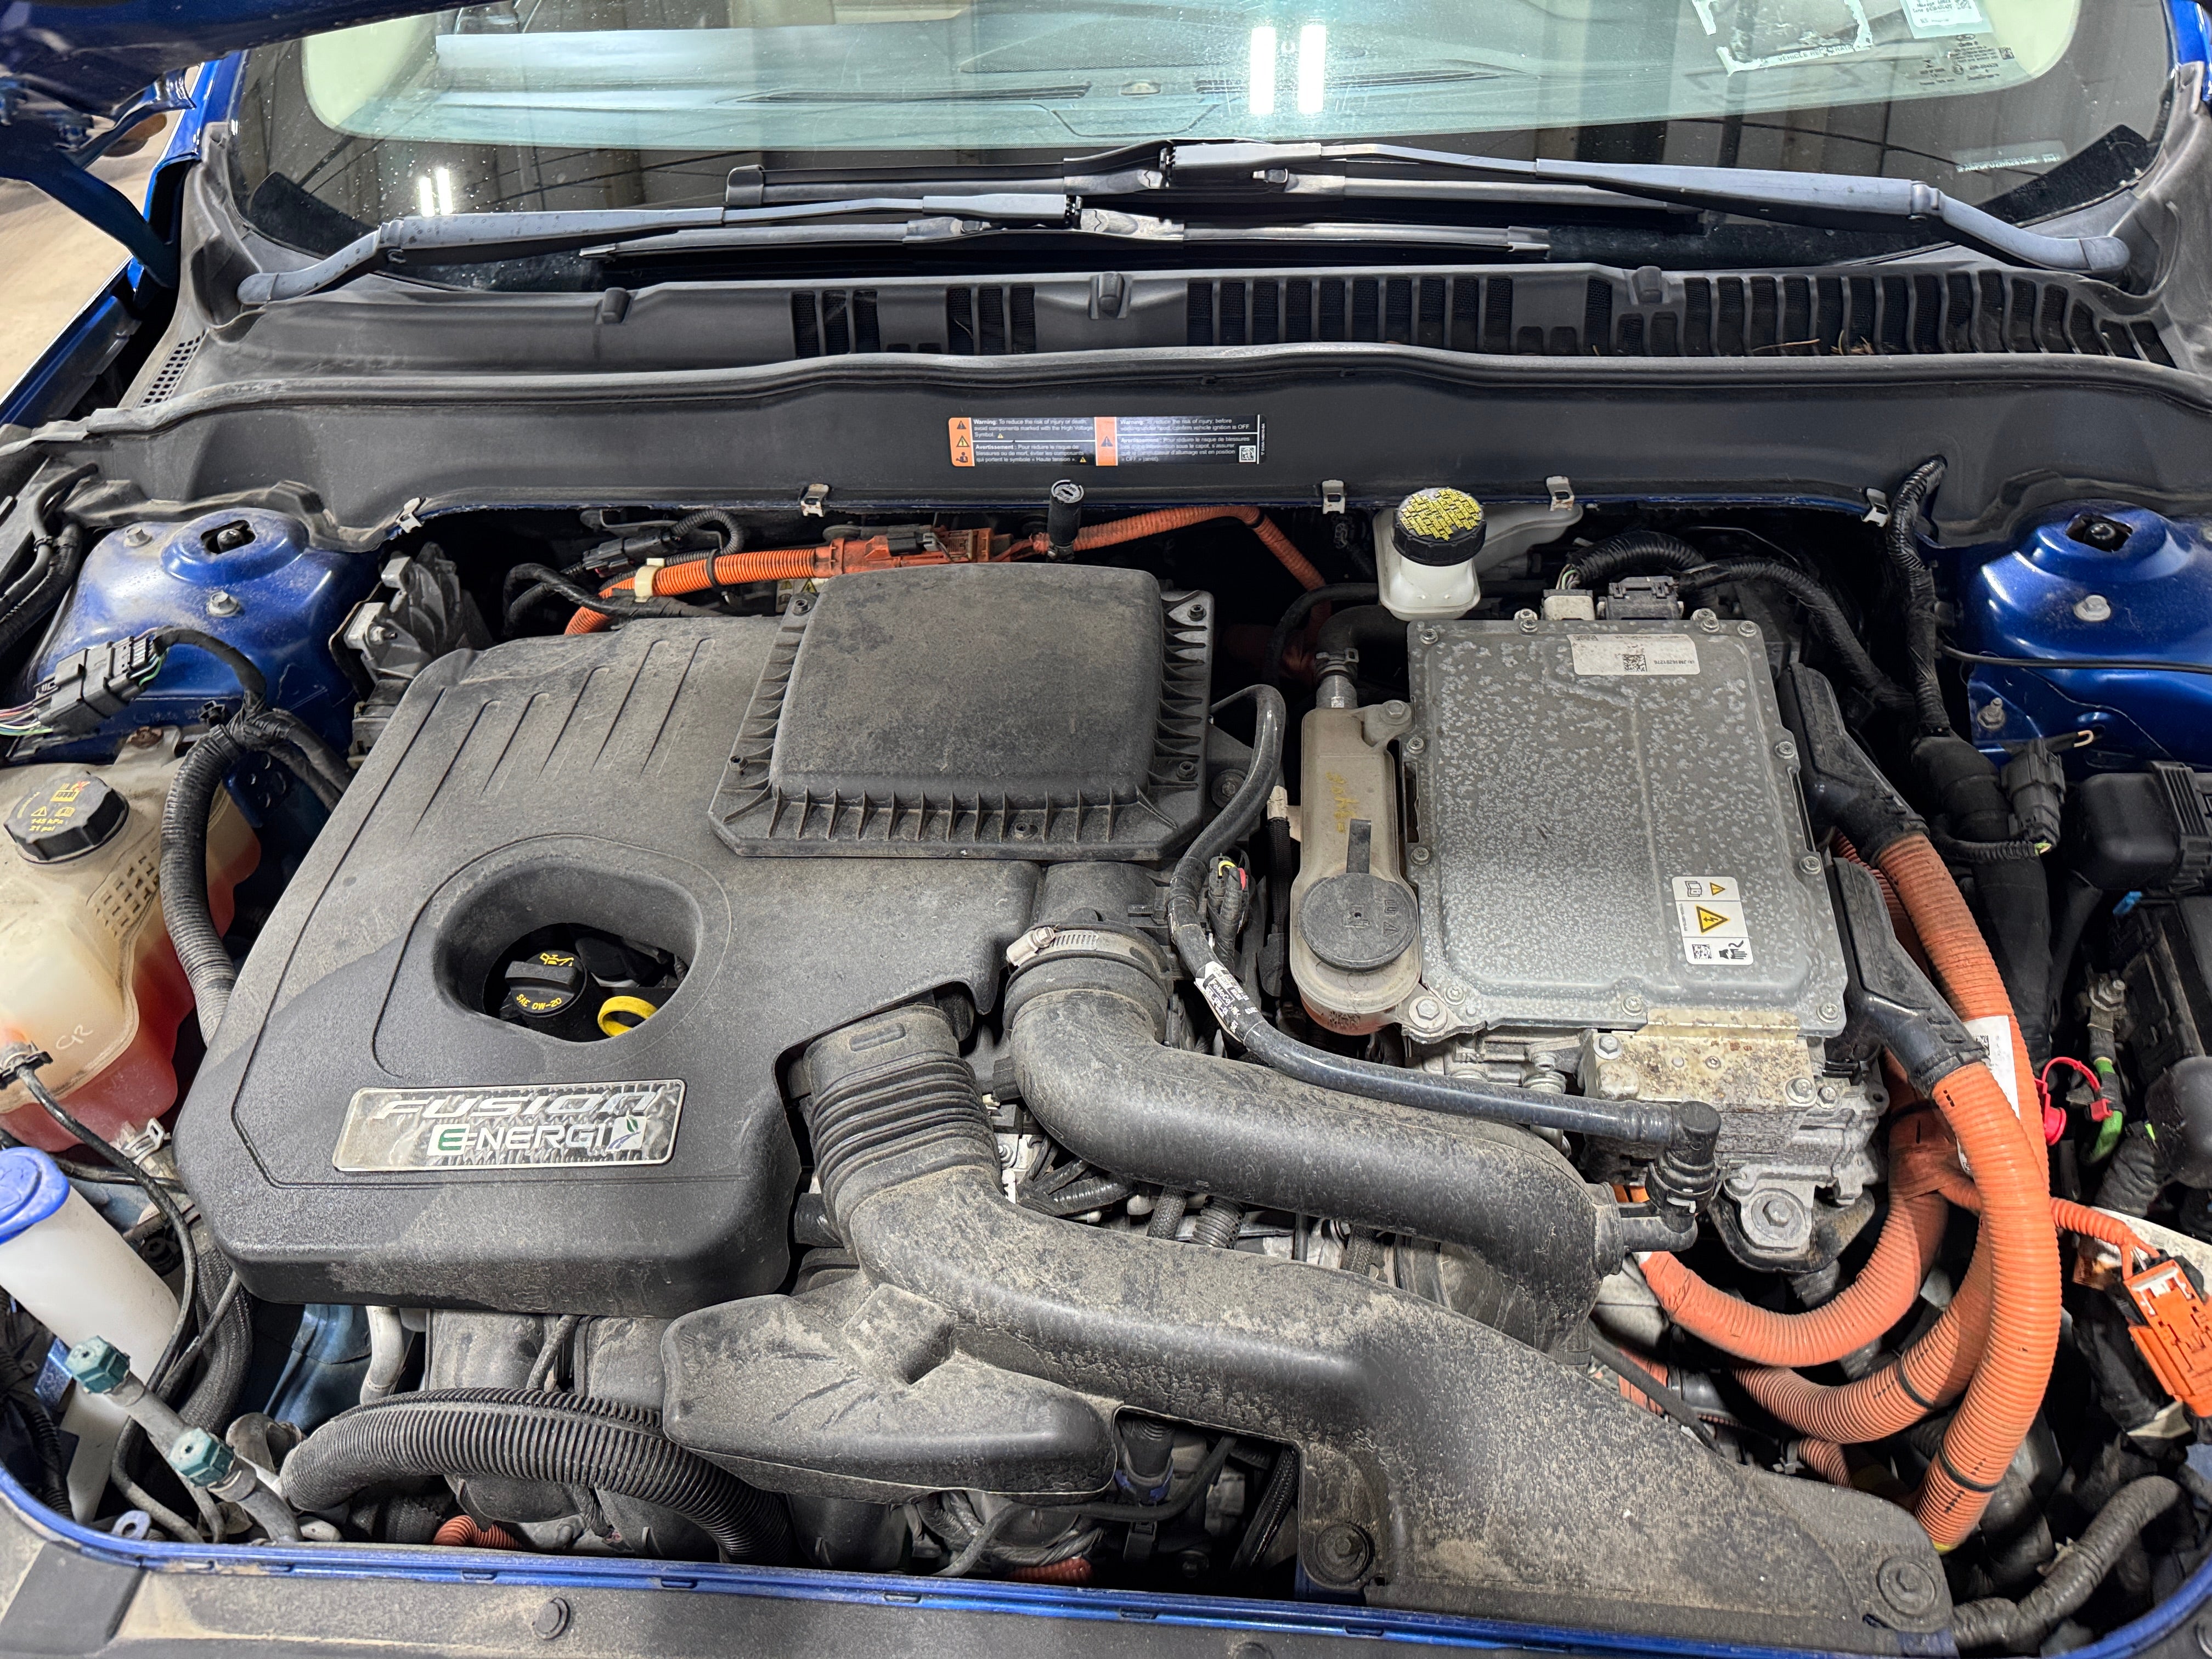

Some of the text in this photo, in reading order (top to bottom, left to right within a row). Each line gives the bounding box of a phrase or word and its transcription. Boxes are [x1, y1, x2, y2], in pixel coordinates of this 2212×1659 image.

[1778, 52, 1809, 61] VEHICLE
[516, 994, 531, 1007] SAE
[1209, 979, 1231, 1004] FoMoCo
[373, 1091, 658, 1120] FUSION
